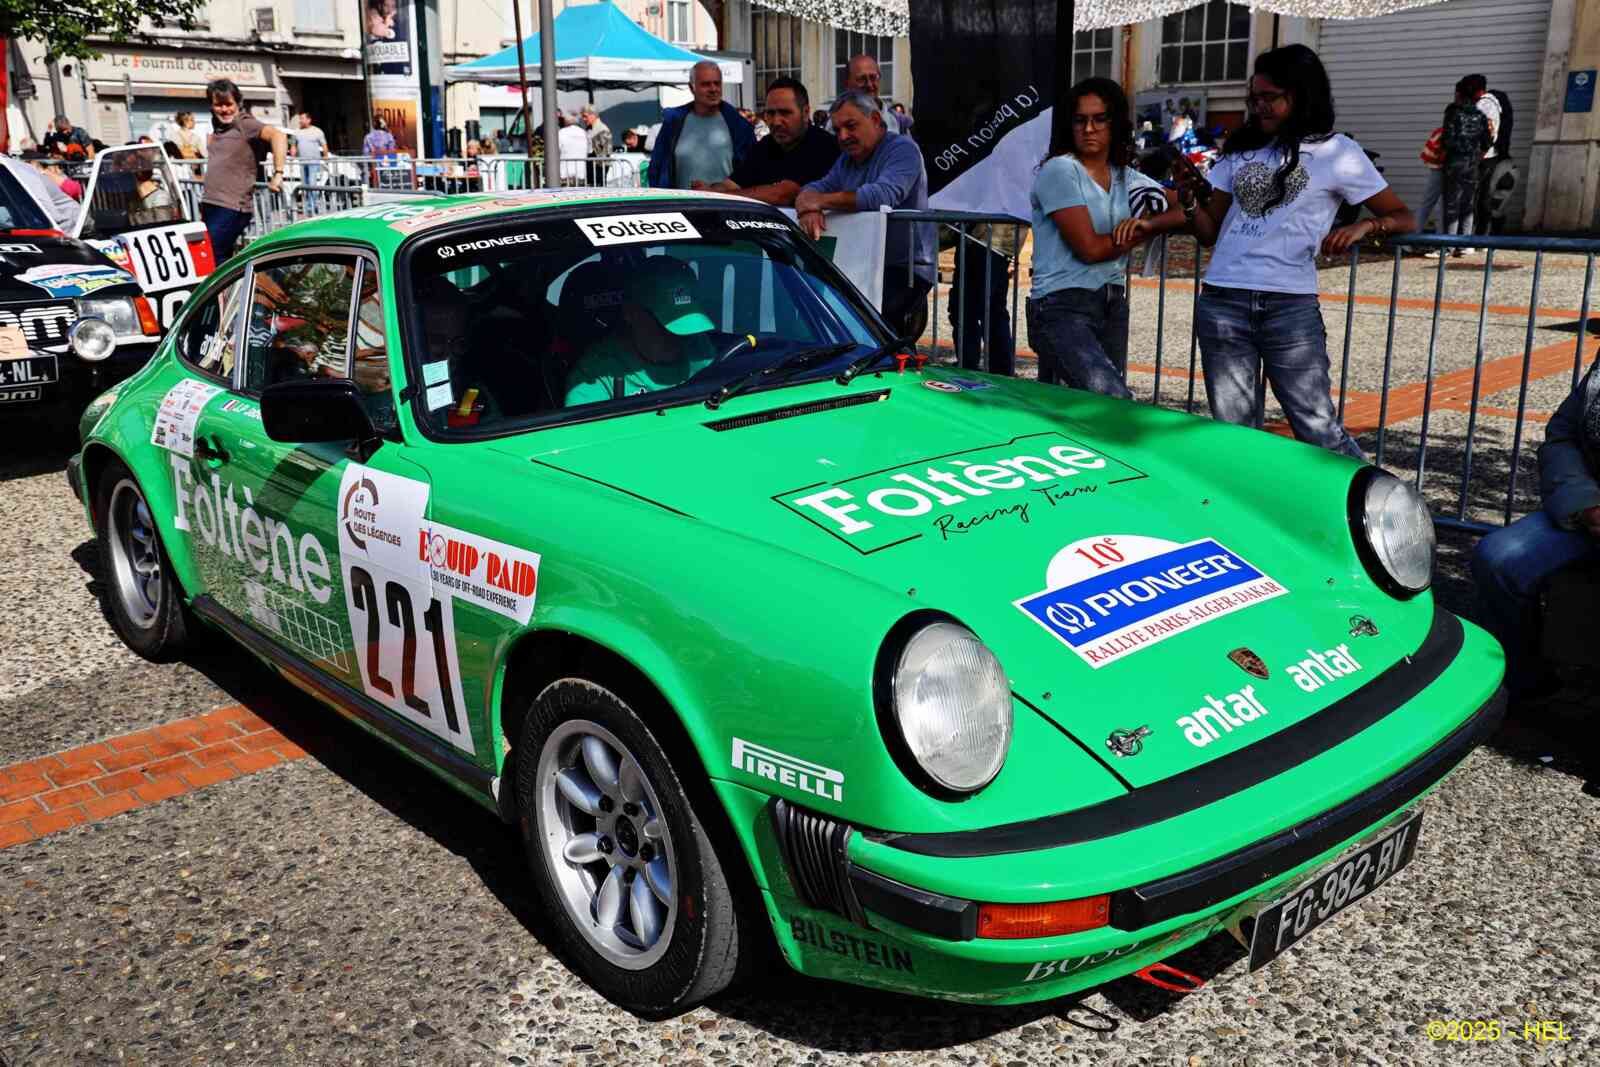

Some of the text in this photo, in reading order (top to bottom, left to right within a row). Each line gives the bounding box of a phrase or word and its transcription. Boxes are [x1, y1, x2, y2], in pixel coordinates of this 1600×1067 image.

[111, 54, 254, 73] Le Fournil de Nicolas
[456, 233, 541, 253] PIONEER
[587, 218, 688, 241] Foltène
[738, 220, 792, 232] PIONEER
[133, 231, 189, 285] 185
[354, 507, 376, 523] ROUTE
[355, 493, 364, 504] LA
[792, 445, 1107, 535] Foltène
[933, 483, 1099, 541] Racing Team
[170, 454, 332, 604] Foltène
[354, 521, 401, 547] DES LÉGENDES
[440, 574, 455, 588] YEARS
[455, 578, 462, 590] OF
[462, 581, 485, 599] OFF-ROAD
[486, 590, 517, 611] EXPERIENCE
[1083, 553, 1243, 617] PIONEER
[351, 566, 461, 734] 221
[1085, 580, 1282, 664] RALLYE PARIS-ALGER-DAKAR
[1286, 643, 1363, 693] antar
[1176, 684, 1269, 748] antar
[731, 736, 845, 802] PIRELLI
[1275, 825, 1411, 952] FG-982-BV
[791, 912, 915, 975] BILSTEIN
